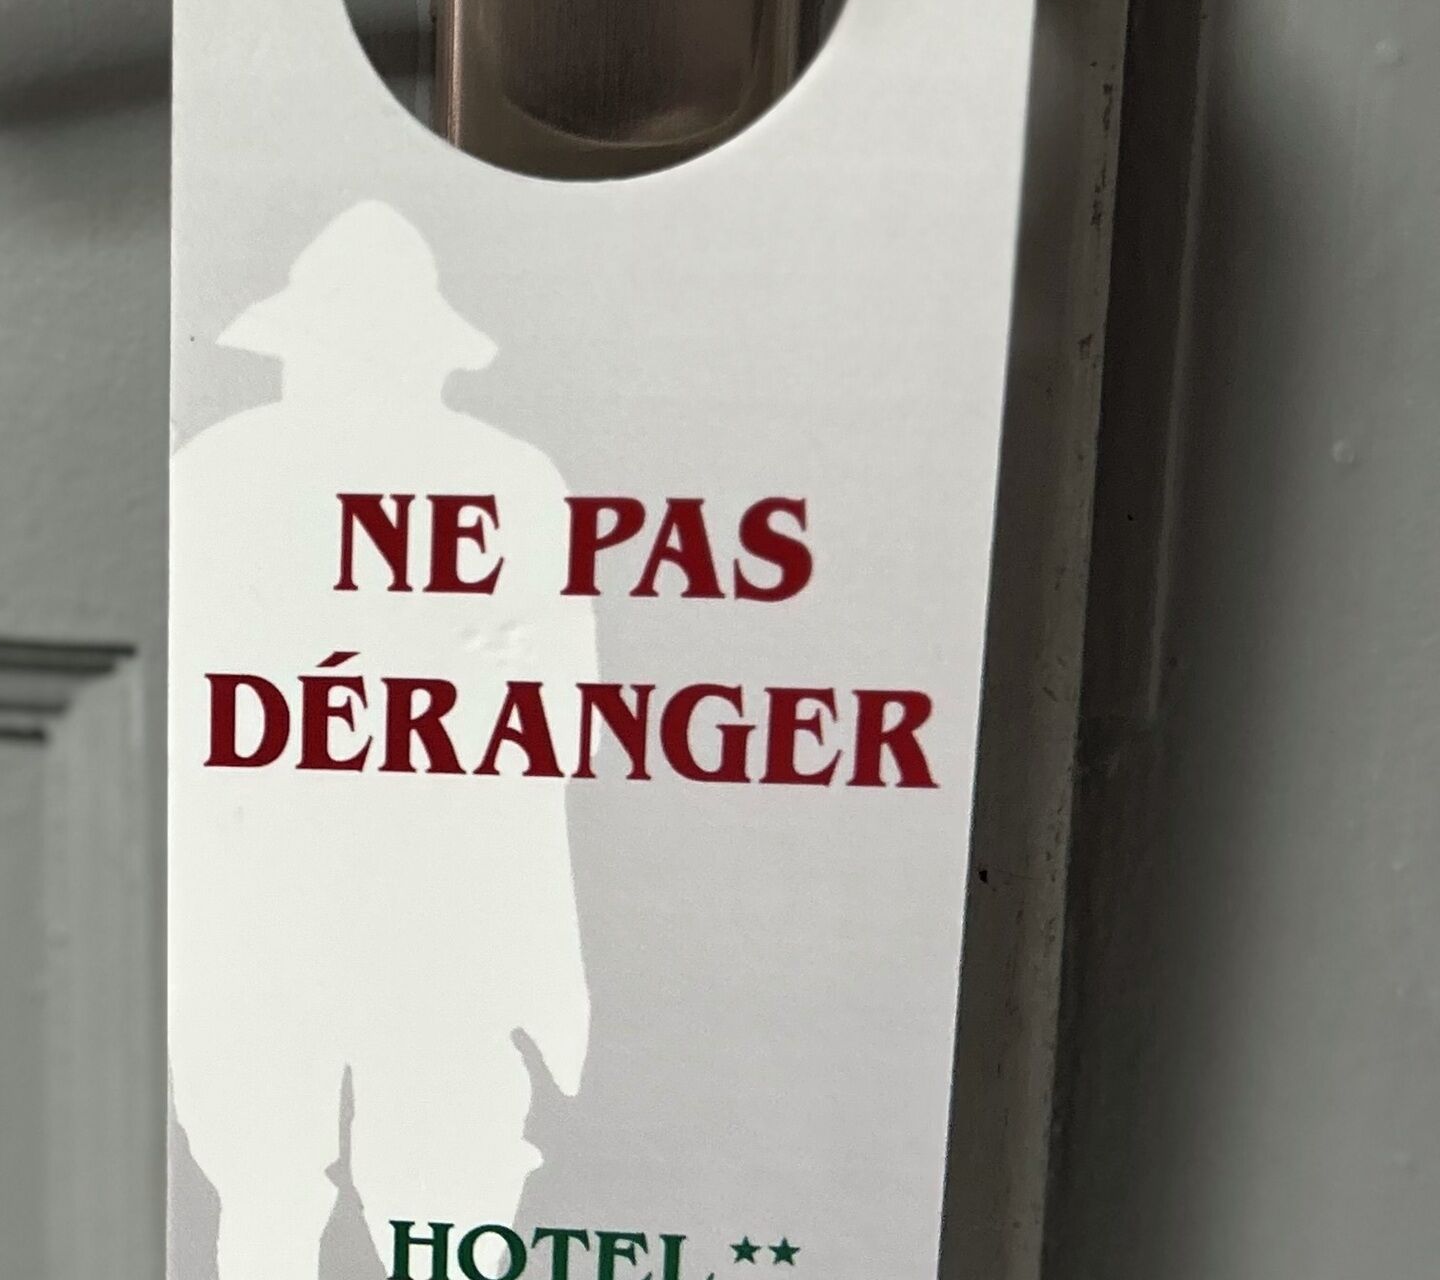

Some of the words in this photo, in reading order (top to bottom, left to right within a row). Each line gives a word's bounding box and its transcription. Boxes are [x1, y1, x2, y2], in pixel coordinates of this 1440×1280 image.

[334, 492, 504, 595] NE
[562, 497, 814, 602] PAS
[204, 651, 939, 789] DÉRANGER
